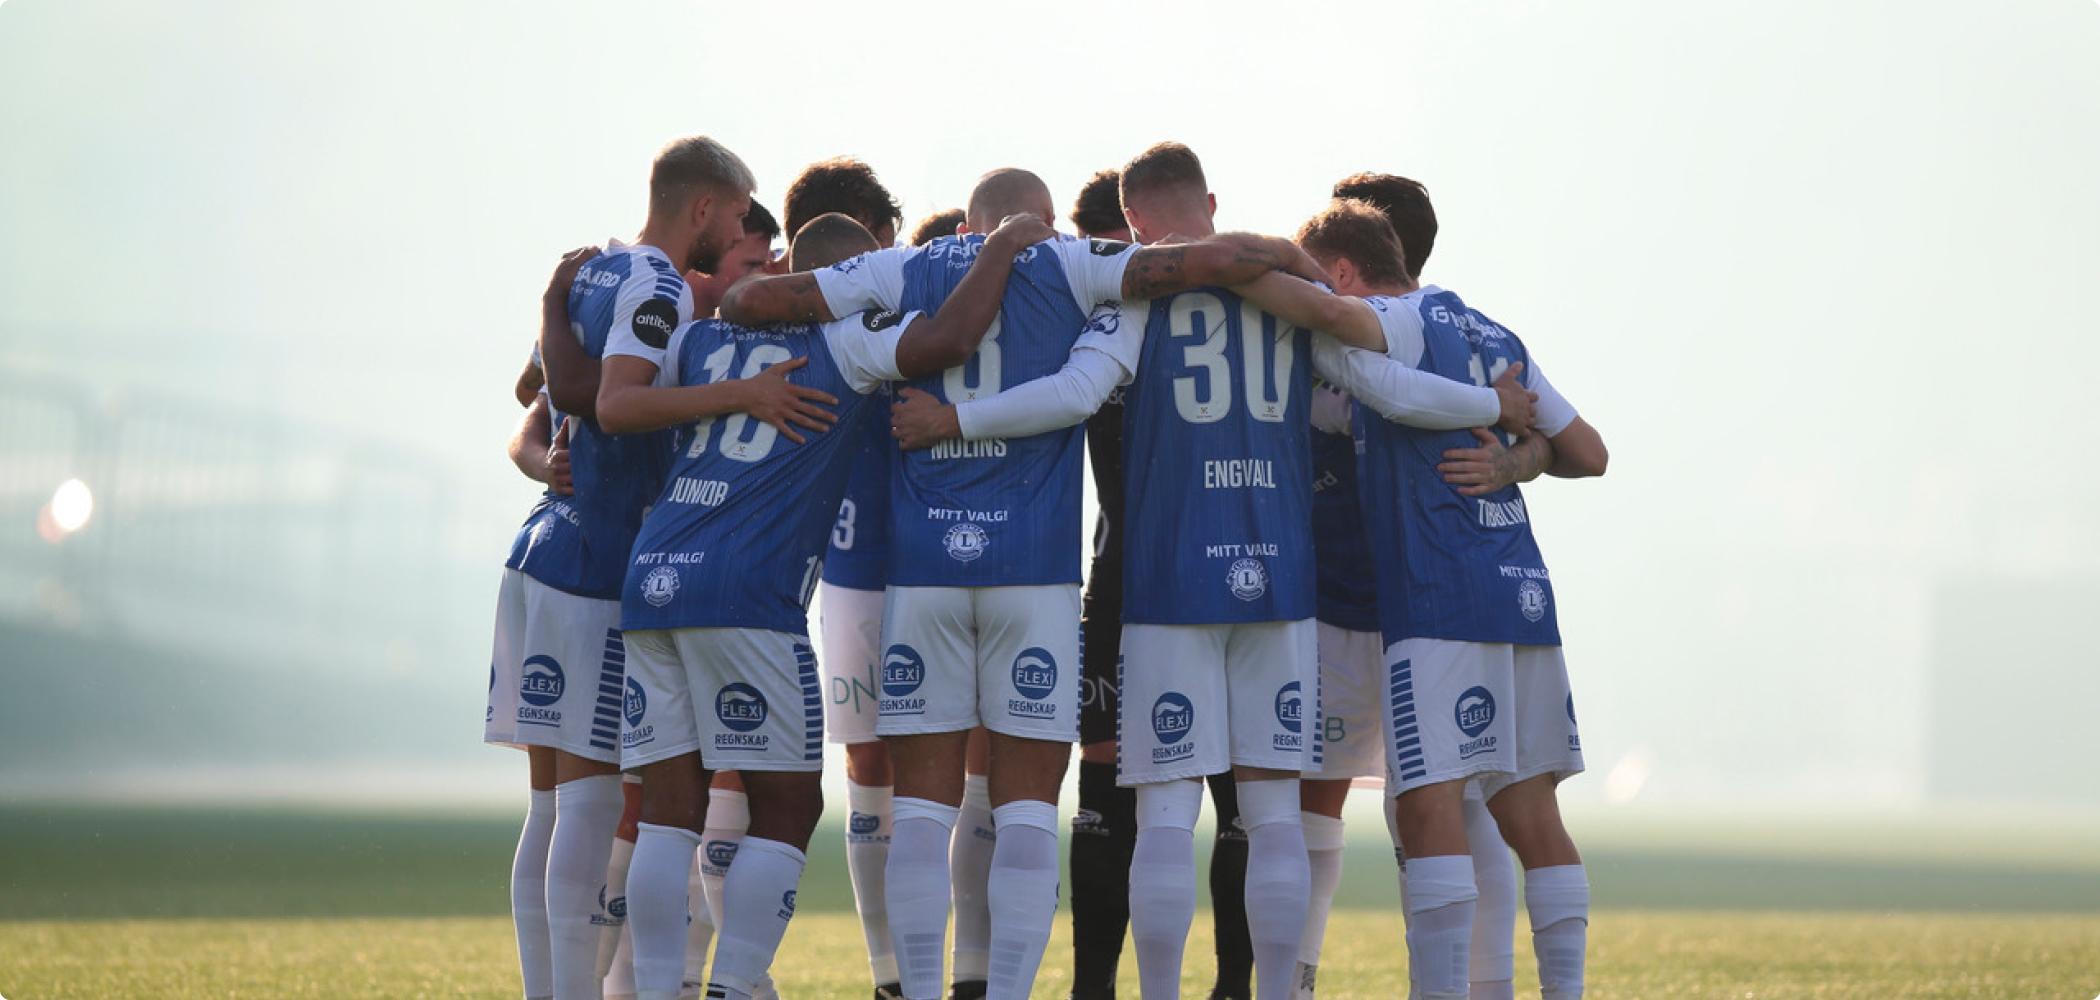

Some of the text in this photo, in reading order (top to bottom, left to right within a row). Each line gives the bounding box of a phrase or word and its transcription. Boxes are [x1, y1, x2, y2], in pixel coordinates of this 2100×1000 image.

[635, 313, 674, 336] altibo
[1169, 291, 1298, 424] 30
[668, 476, 730, 507] JUNIOR
[927, 506, 1009, 523] MITT VALG!
[1477, 498, 1527, 528] TIBBLIN
[634, 550, 705, 566] MITT VALG!
[1206, 544, 1241, 558] MITT
[833, 664, 878, 714] DN
[1081, 664, 1120, 712] DN
[879, 698, 926, 712] EGNSKAP
[1008, 698, 1057, 716] REGNSKAP
[1280, 703, 1302, 718] FLE
[517, 706, 562, 722] EGNSKAP
[714, 733, 769, 747] REGNSKAP
[1272, 733, 1302, 747] REGN
